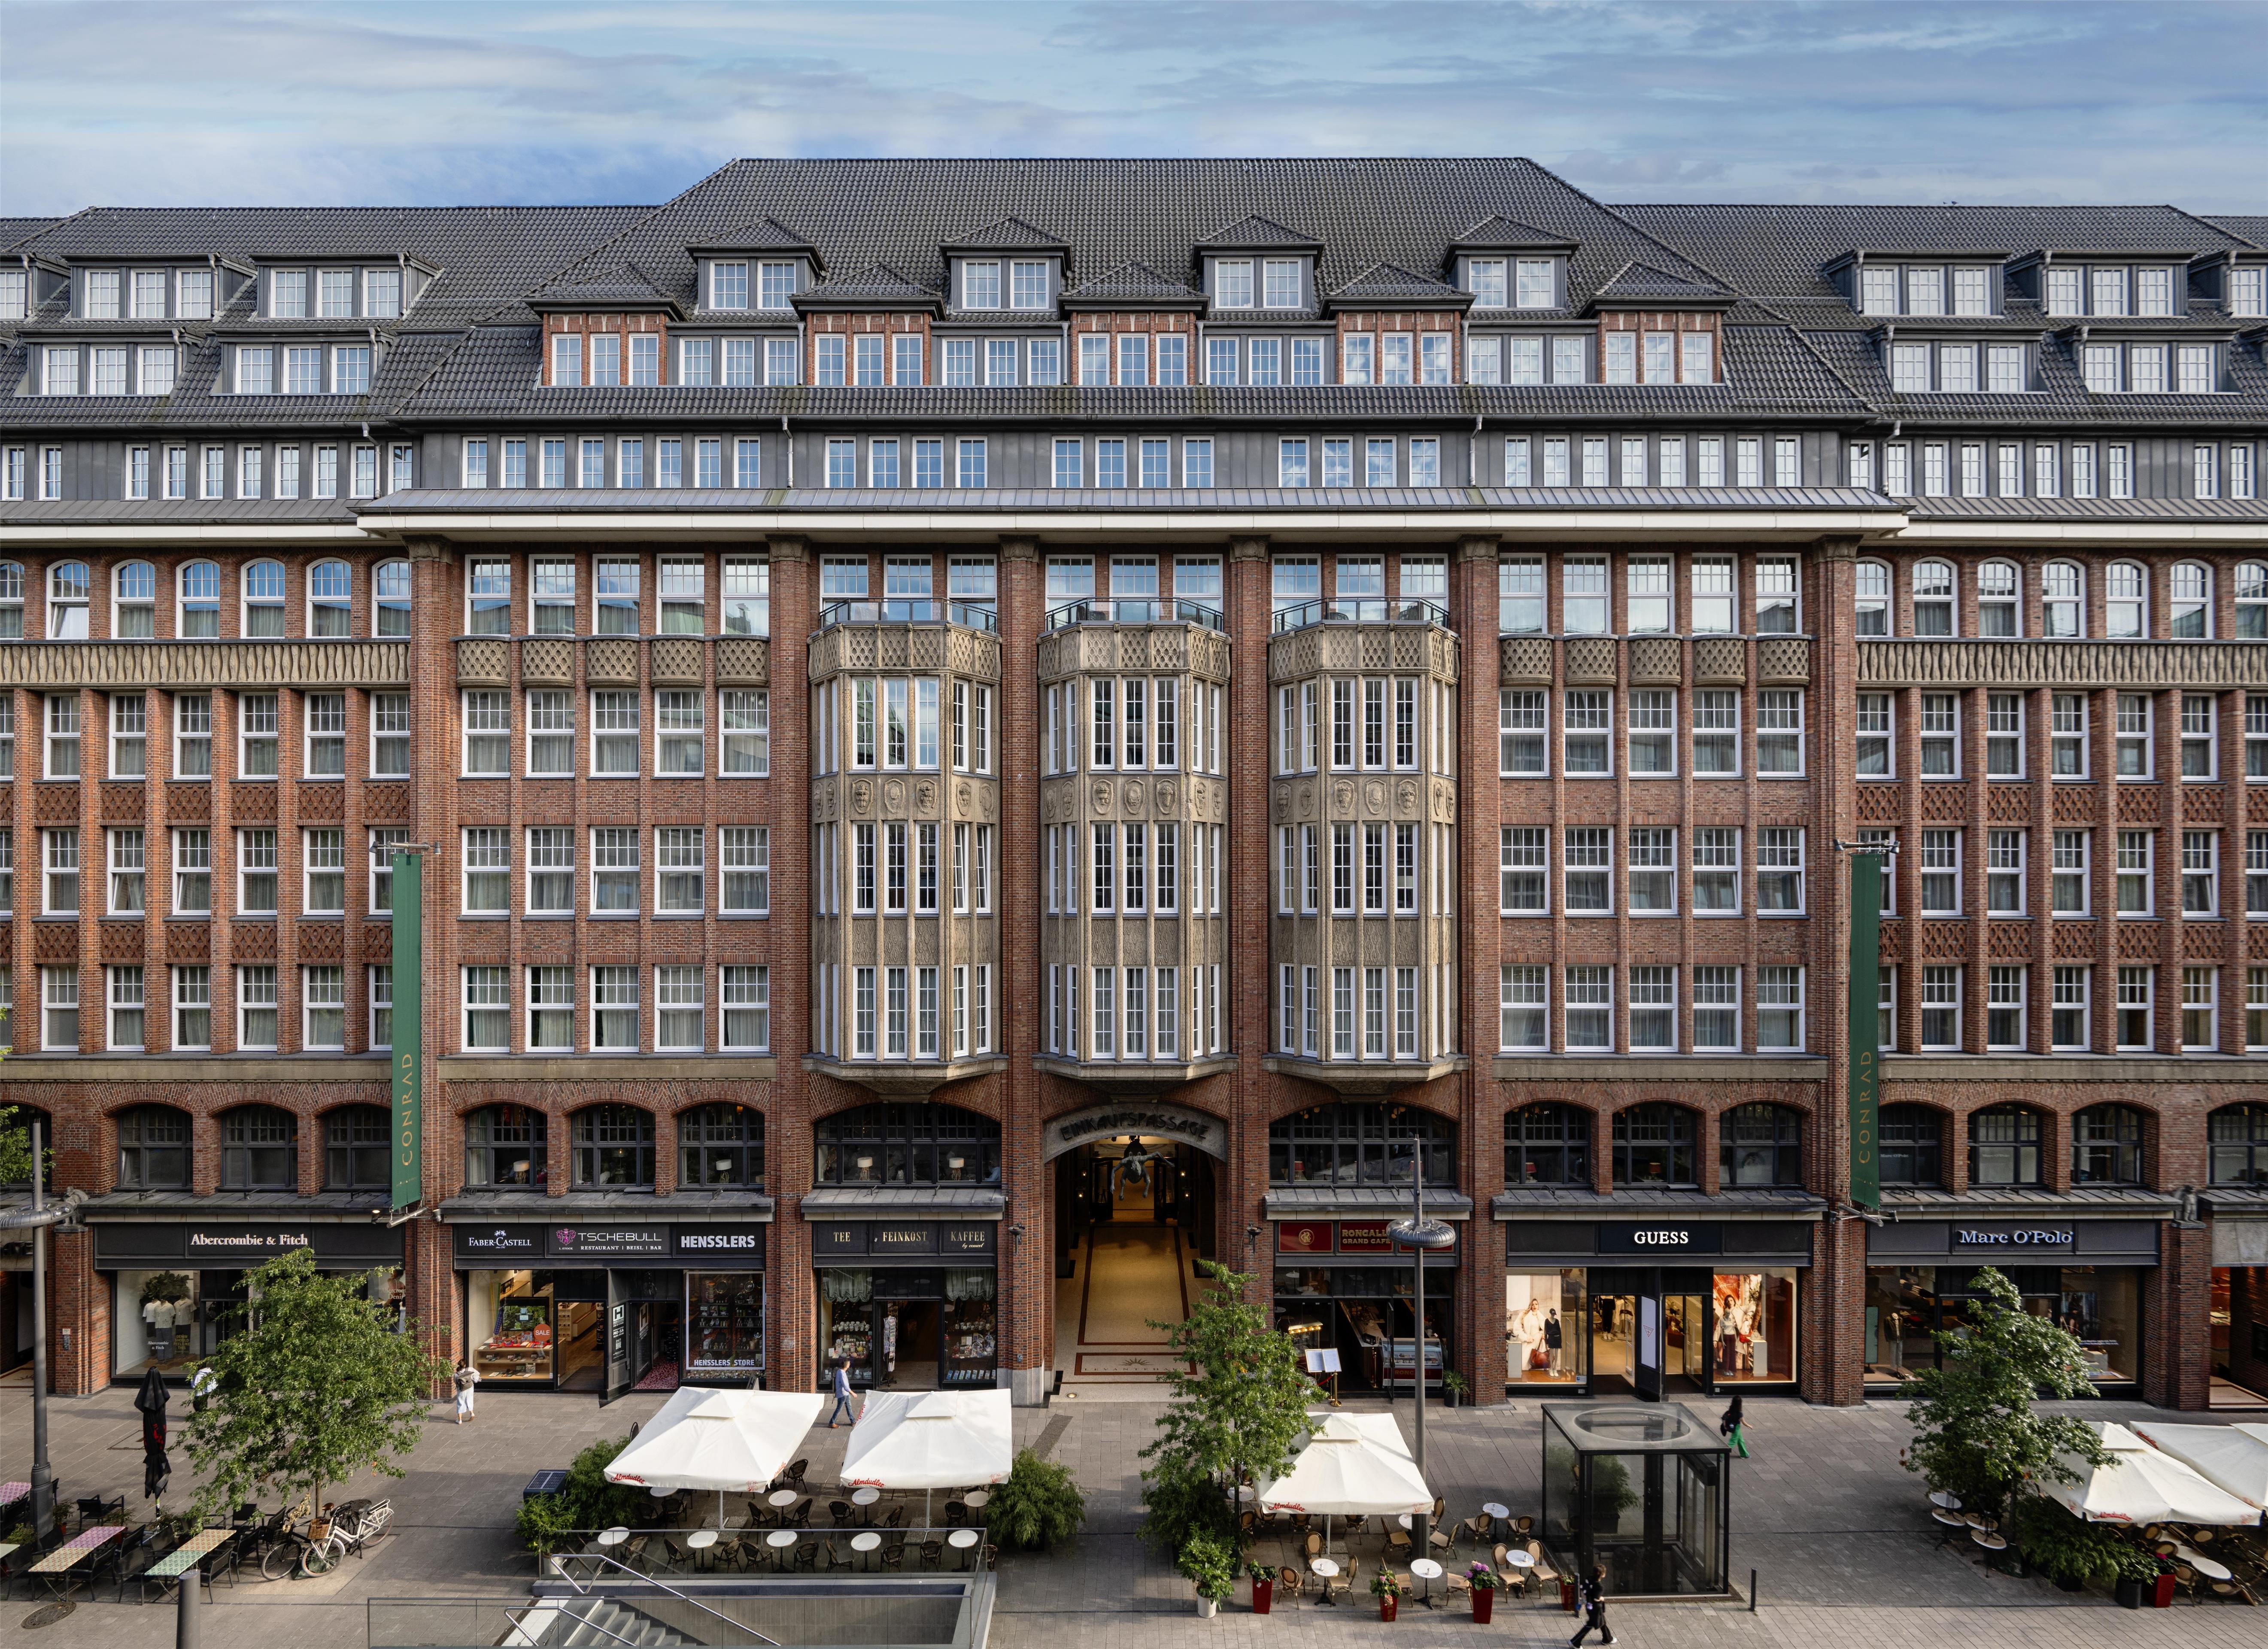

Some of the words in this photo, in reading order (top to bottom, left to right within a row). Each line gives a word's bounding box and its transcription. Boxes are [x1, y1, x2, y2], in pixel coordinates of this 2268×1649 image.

[402, 1054, 412, 1165] CONRAD
[1859, 1052, 1871, 1163] CONRAD
[1060, 1112, 1210, 1141] EINKAUFSPASSAGE
[190, 1234, 263, 1245] Abercrombie
[266, 1236, 276, 1245] &
[279, 1234, 308, 1245] Fitch
[578, 1233, 662, 1241] TSCHEBULL
[681, 1235, 755, 1247] HENSSLERS
[834, 1232, 850, 1242] TEE
[883, 1231, 927, 1241] FEINKOST
[951, 1231, 985, 1241] KAFFEE
[1634, 1231, 1688, 1244] GUESS
[1956, 1230, 2008, 1243] Marc
[610, 1473, 645, 1484] Almdudler
[848, 1478, 884, 1488] Almdudler
[1268, 1502, 1305, 1512] Almdudler
